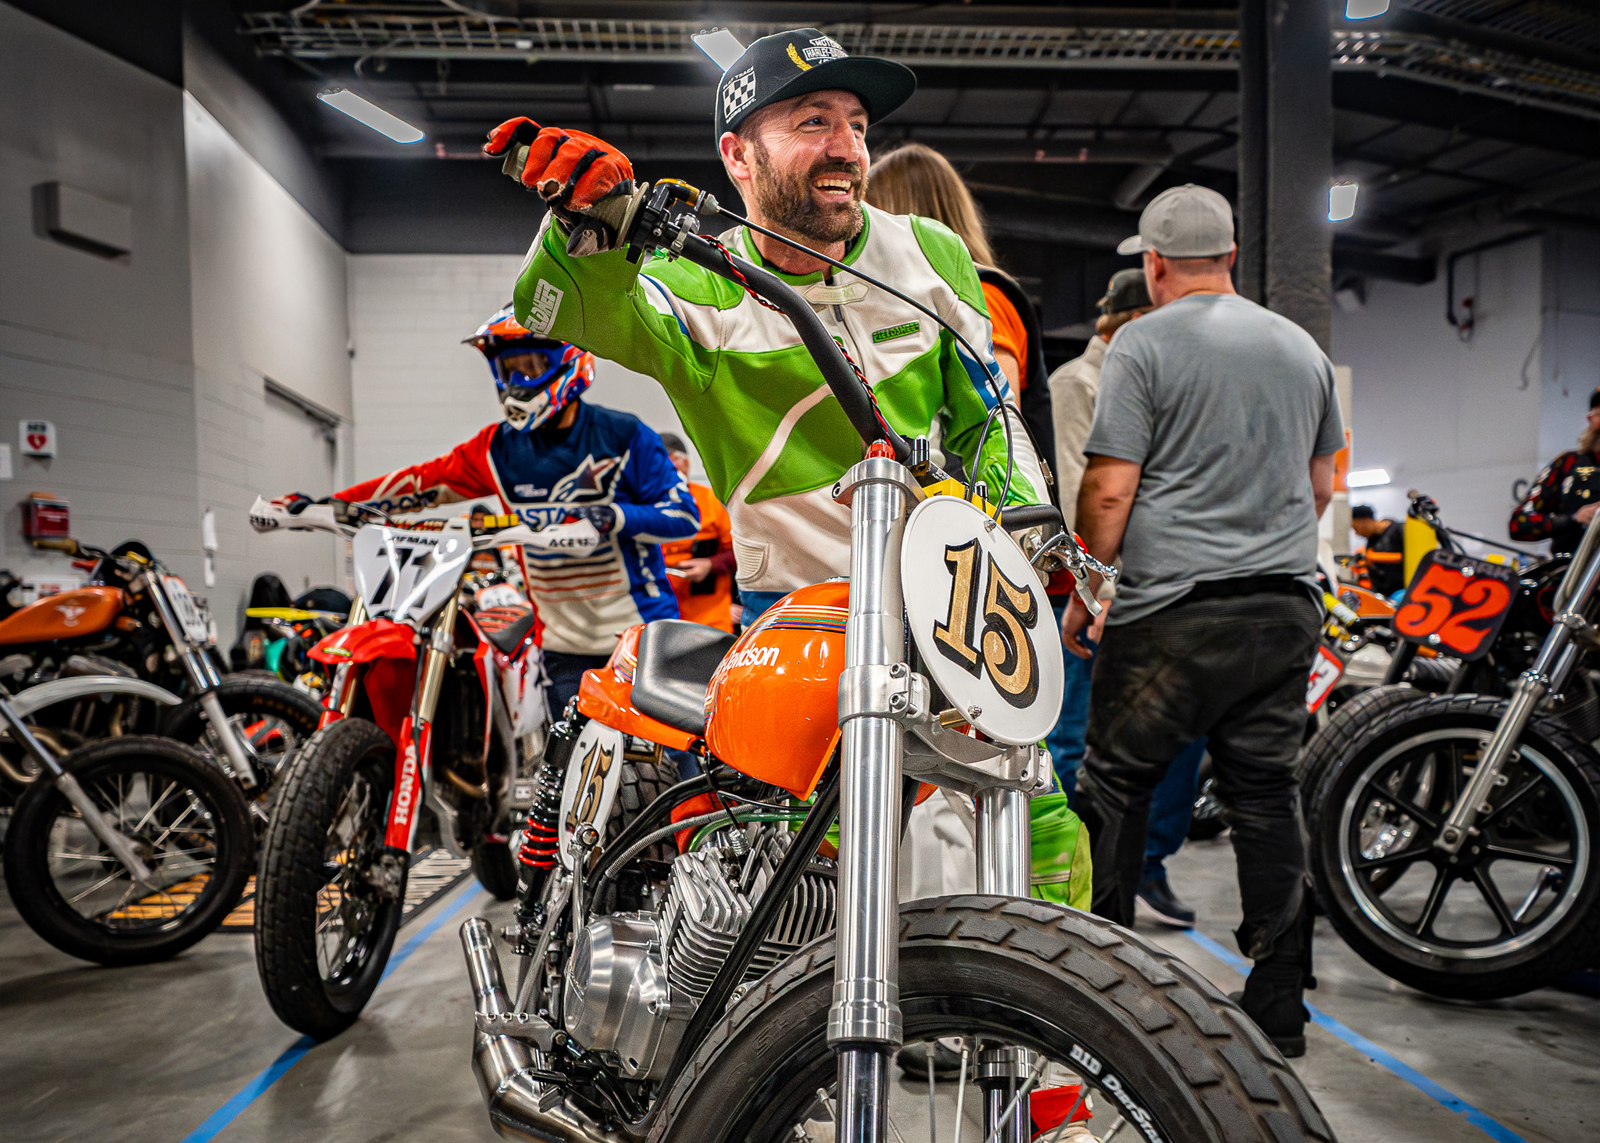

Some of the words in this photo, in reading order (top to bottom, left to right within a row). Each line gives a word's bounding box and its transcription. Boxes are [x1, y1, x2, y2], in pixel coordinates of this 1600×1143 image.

[933, 537, 1040, 709] 15
[1395, 563, 1511, 653] 52
[393, 743, 417, 826] HONDA
[565, 737, 616, 834] 15
[1069, 1043, 1103, 1076] DID
